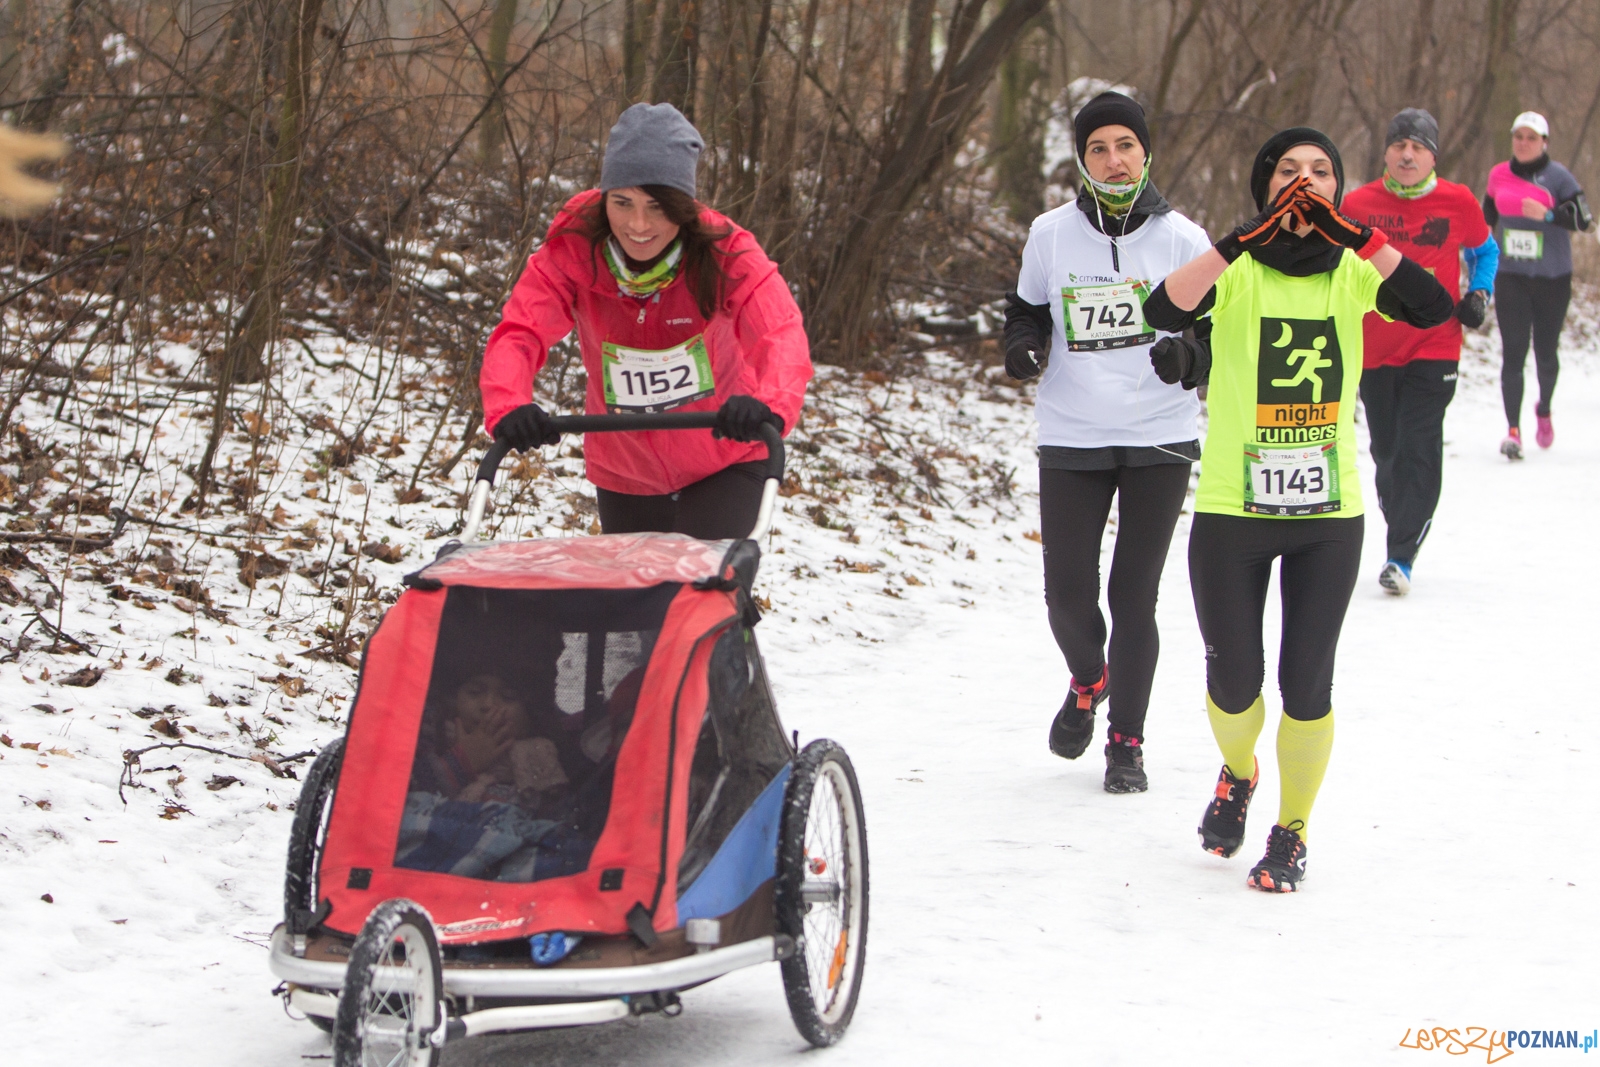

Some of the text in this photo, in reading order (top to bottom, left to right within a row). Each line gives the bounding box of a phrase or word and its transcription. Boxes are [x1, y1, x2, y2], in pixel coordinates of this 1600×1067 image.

[1368, 214, 1404, 229] DZIKA
[1511, 239, 1532, 251] 145
[1079, 302, 1135, 331] 742
[1091, 330, 1128, 339] KATARZYNA
[621, 364, 693, 396] 1152
[1275, 404, 1327, 426] night
[1257, 424, 1336, 443] runners
[1261, 467, 1324, 495] 1143
[1281, 497, 1307, 505] ASIULA
